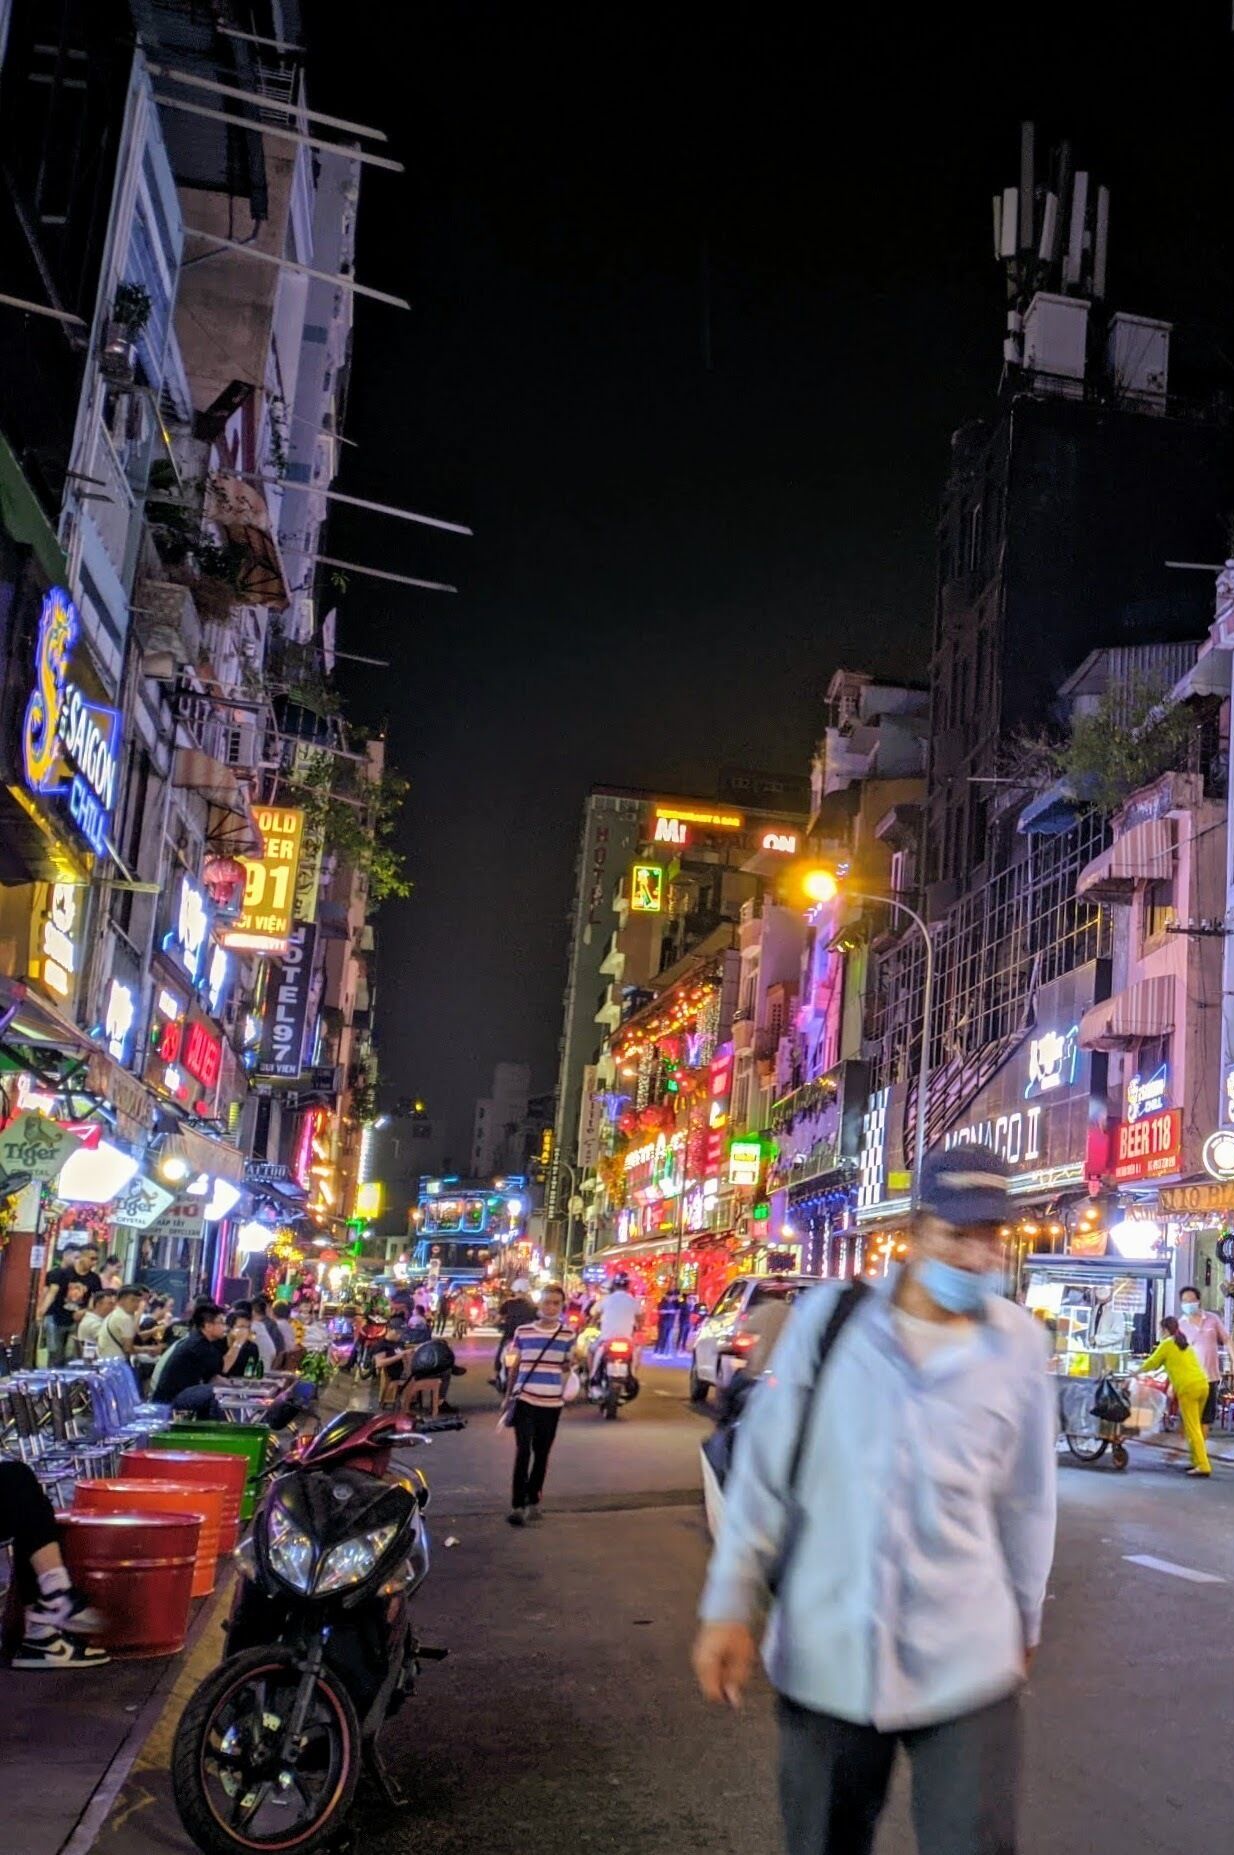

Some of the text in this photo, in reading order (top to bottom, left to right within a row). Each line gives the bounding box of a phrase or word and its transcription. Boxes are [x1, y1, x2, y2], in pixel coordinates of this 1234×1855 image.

[65, 690, 116, 811] SAIGON
[258, 811, 297, 834] OLD
[264, 837, 295, 860] ER
[255, 914, 287, 934] VIỆN
[1119, 1115, 1172, 1161] BEER 118
[4, 1141, 60, 1167] Tiger
[114, 1196, 156, 1216] Tiger
[116, 1216, 146, 1225] CRYSTAL
